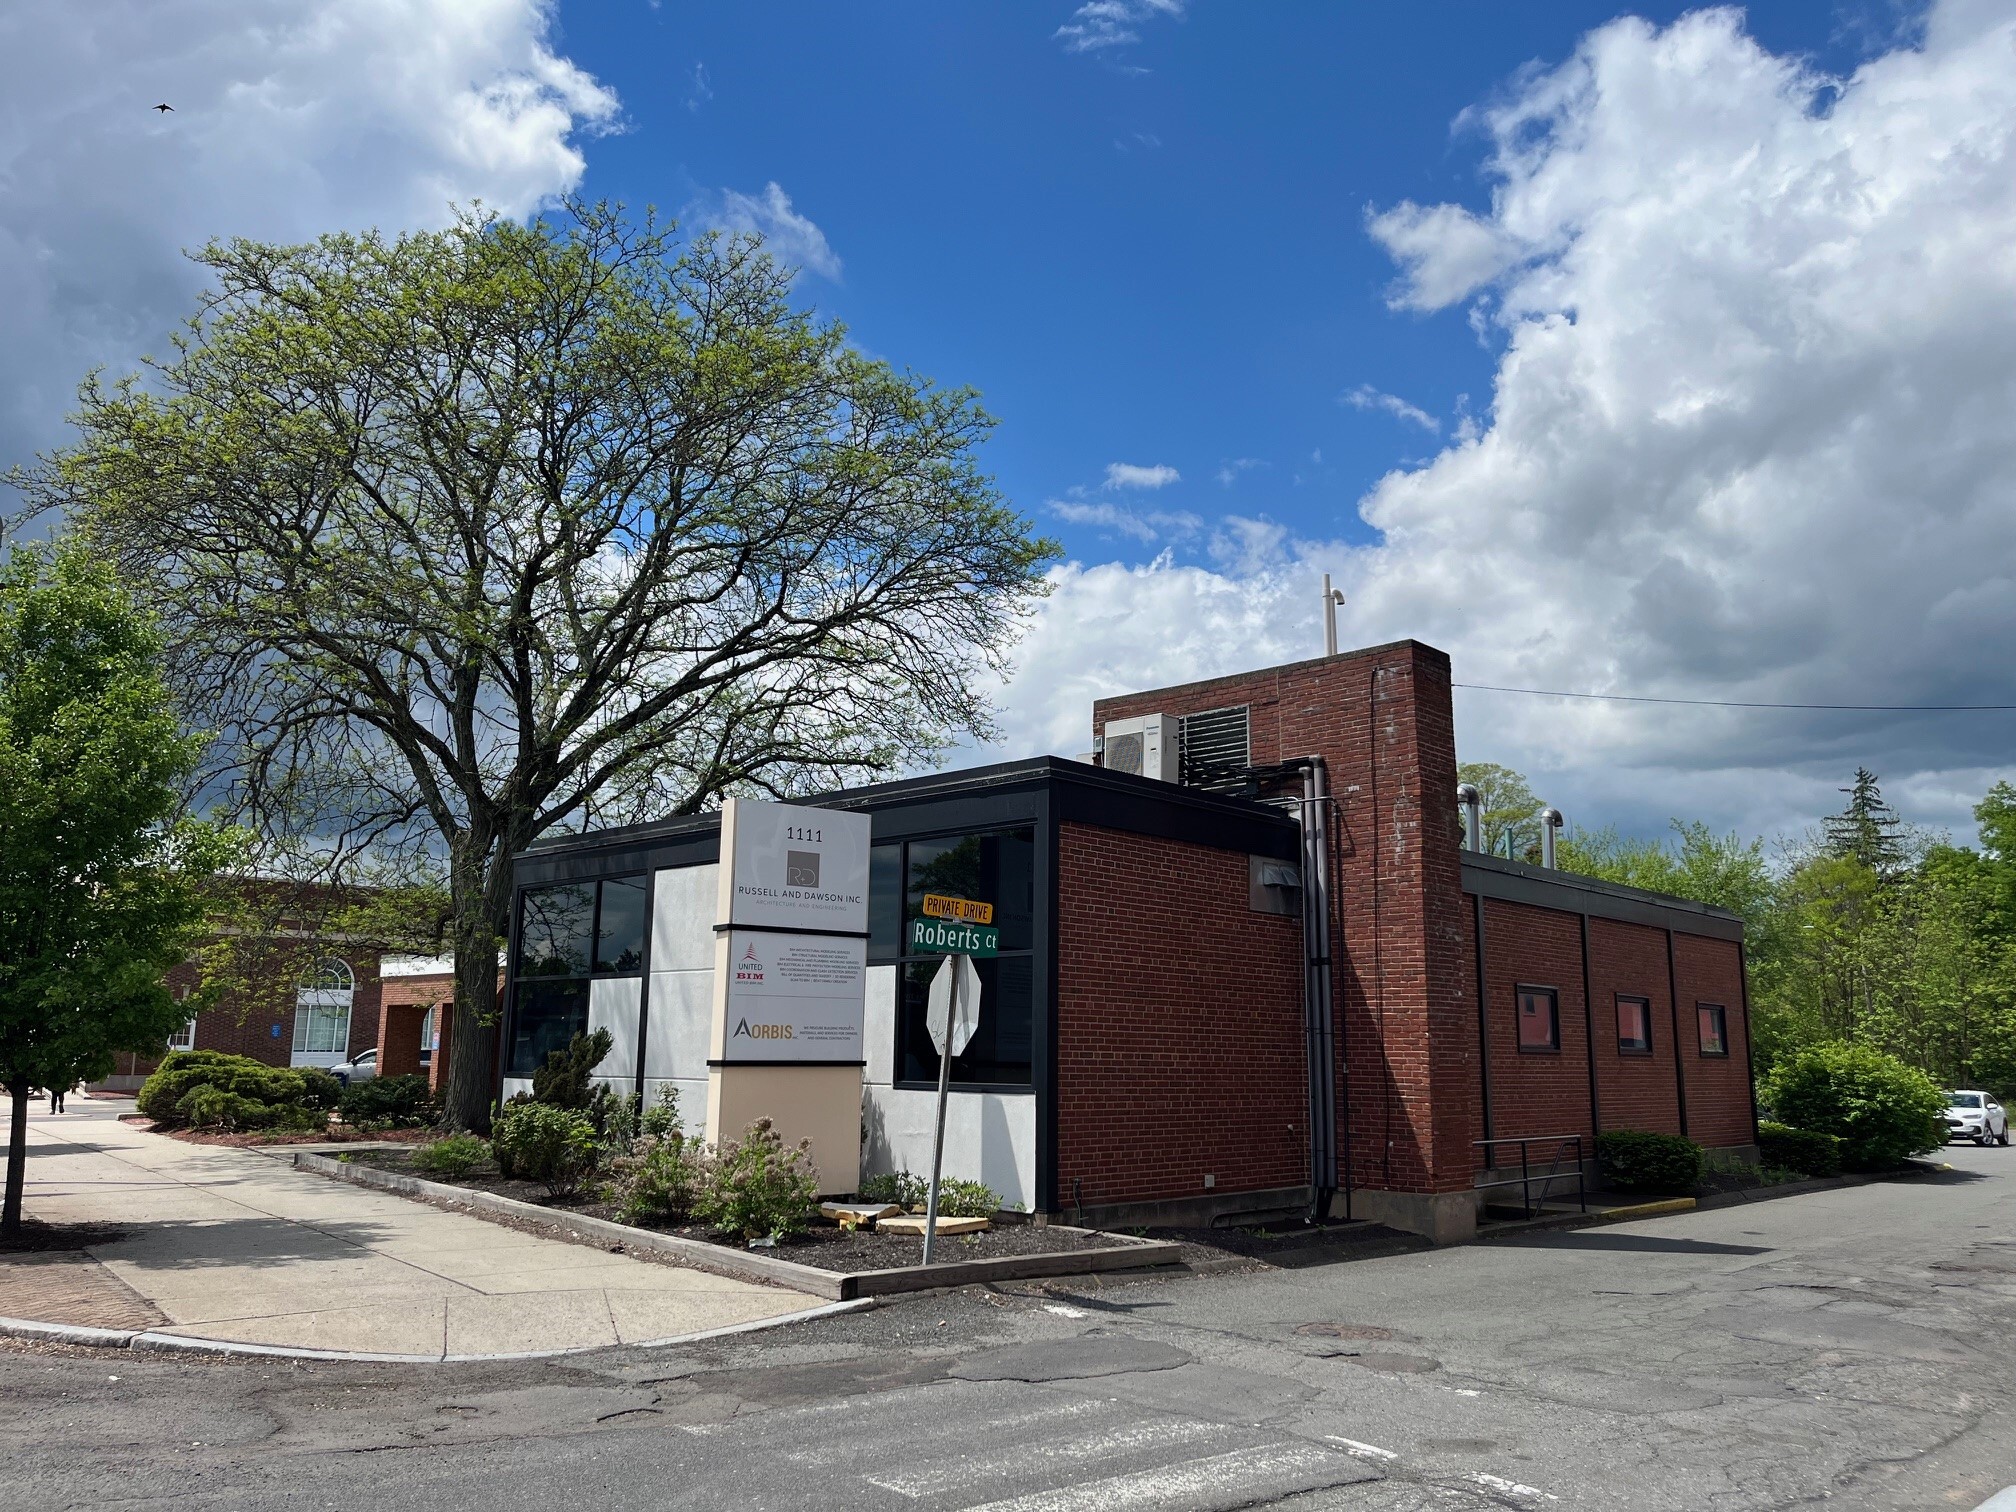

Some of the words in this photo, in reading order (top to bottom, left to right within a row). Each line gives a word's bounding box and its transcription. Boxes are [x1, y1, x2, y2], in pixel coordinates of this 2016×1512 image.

[787, 826, 823, 843] 1111
[738, 886, 778, 897] RUSSELL
[782, 889, 802, 899] AND
[804, 891, 843, 902] DAWSON
[845, 895, 863, 904] INC.
[755, 899, 796, 907] ARCHITECTURE
[811, 904, 847, 912] ENGINEERING
[927, 897, 960, 916] PRIVATE
[963, 903, 989, 920] DRIVE
[914, 922, 980, 950] Roberts
[985, 934, 997, 949] Ct
[738, 963, 763, 971] UNITED
[736, 972, 764, 980] BIM
